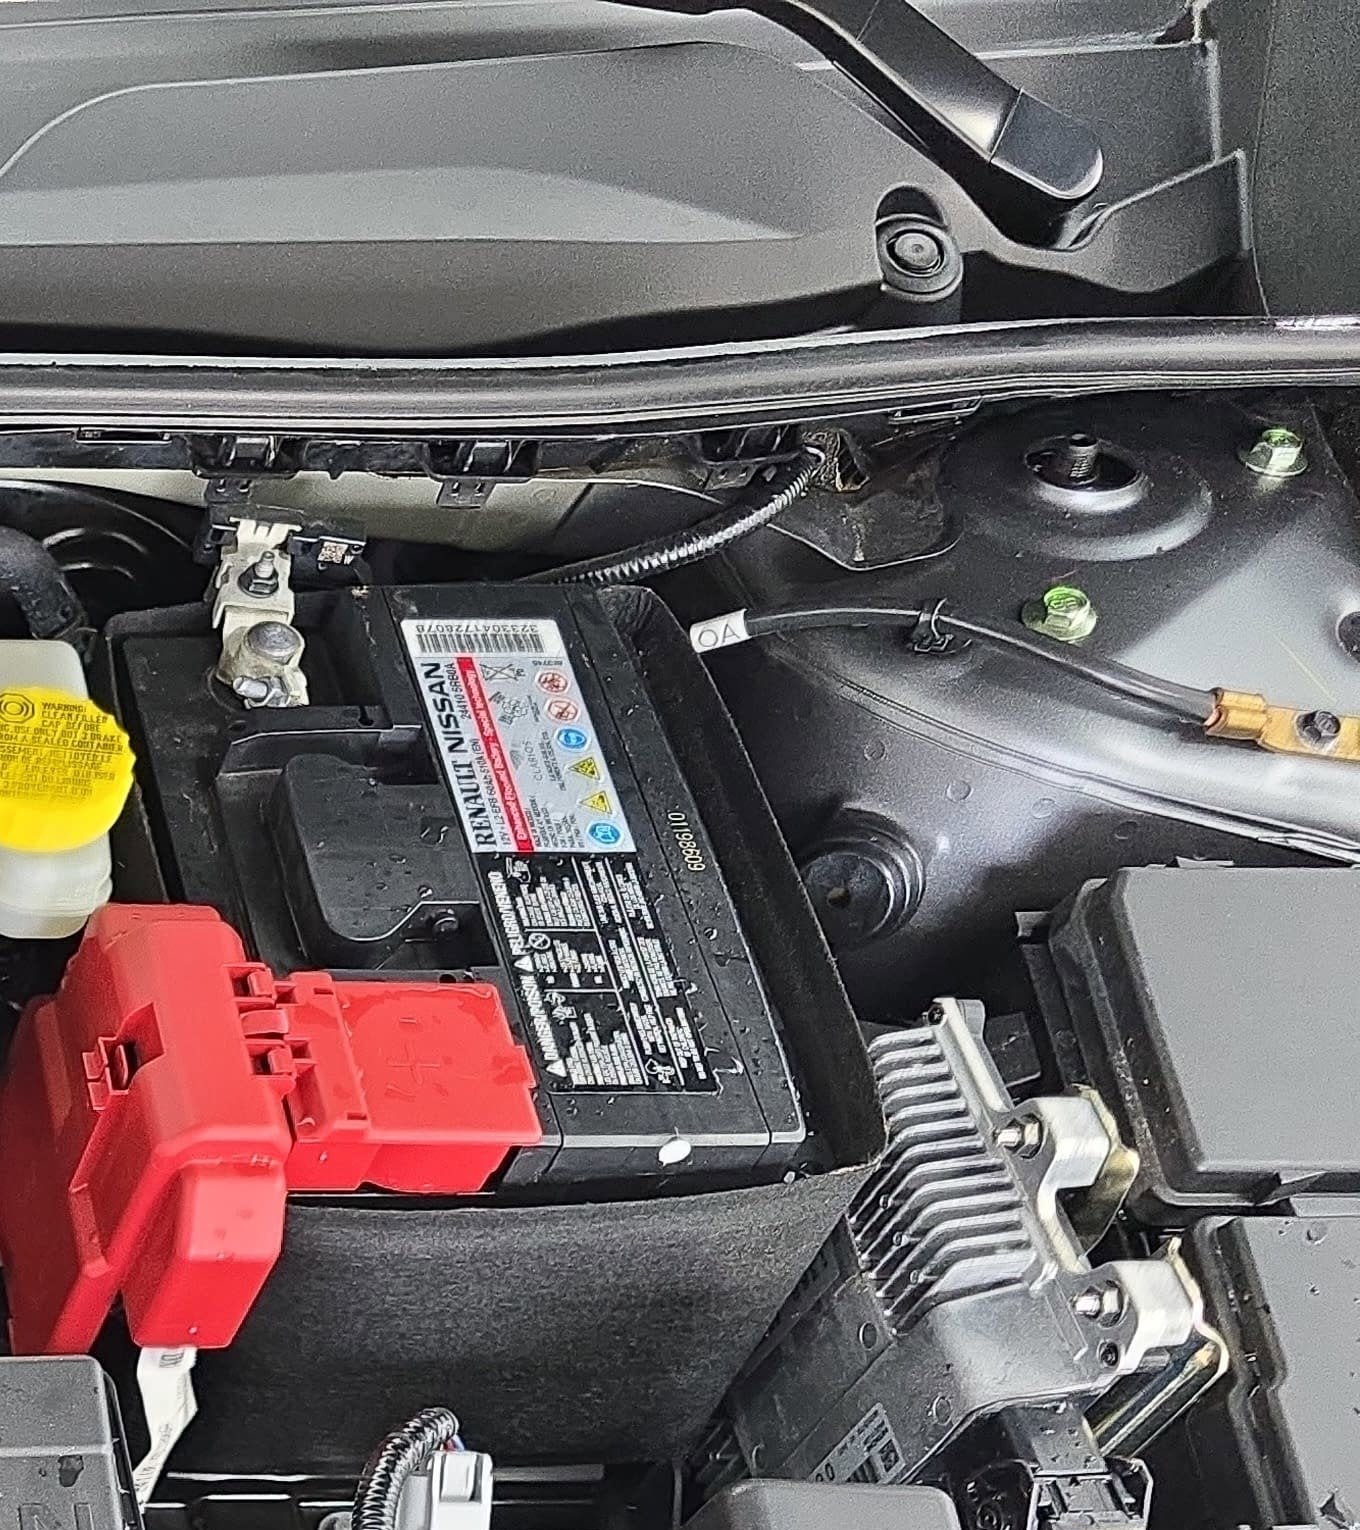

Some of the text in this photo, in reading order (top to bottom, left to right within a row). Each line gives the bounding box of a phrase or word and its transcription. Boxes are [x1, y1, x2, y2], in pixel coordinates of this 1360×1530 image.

[42, 720, 101, 732] CAP BEFORE
[32, 736, 68, 747] SEALED
[34, 727, 57, 737] ONLY
[90, 733, 122, 743] BRAKE
[420, 662, 497, 846] RENAULT NISSAN
